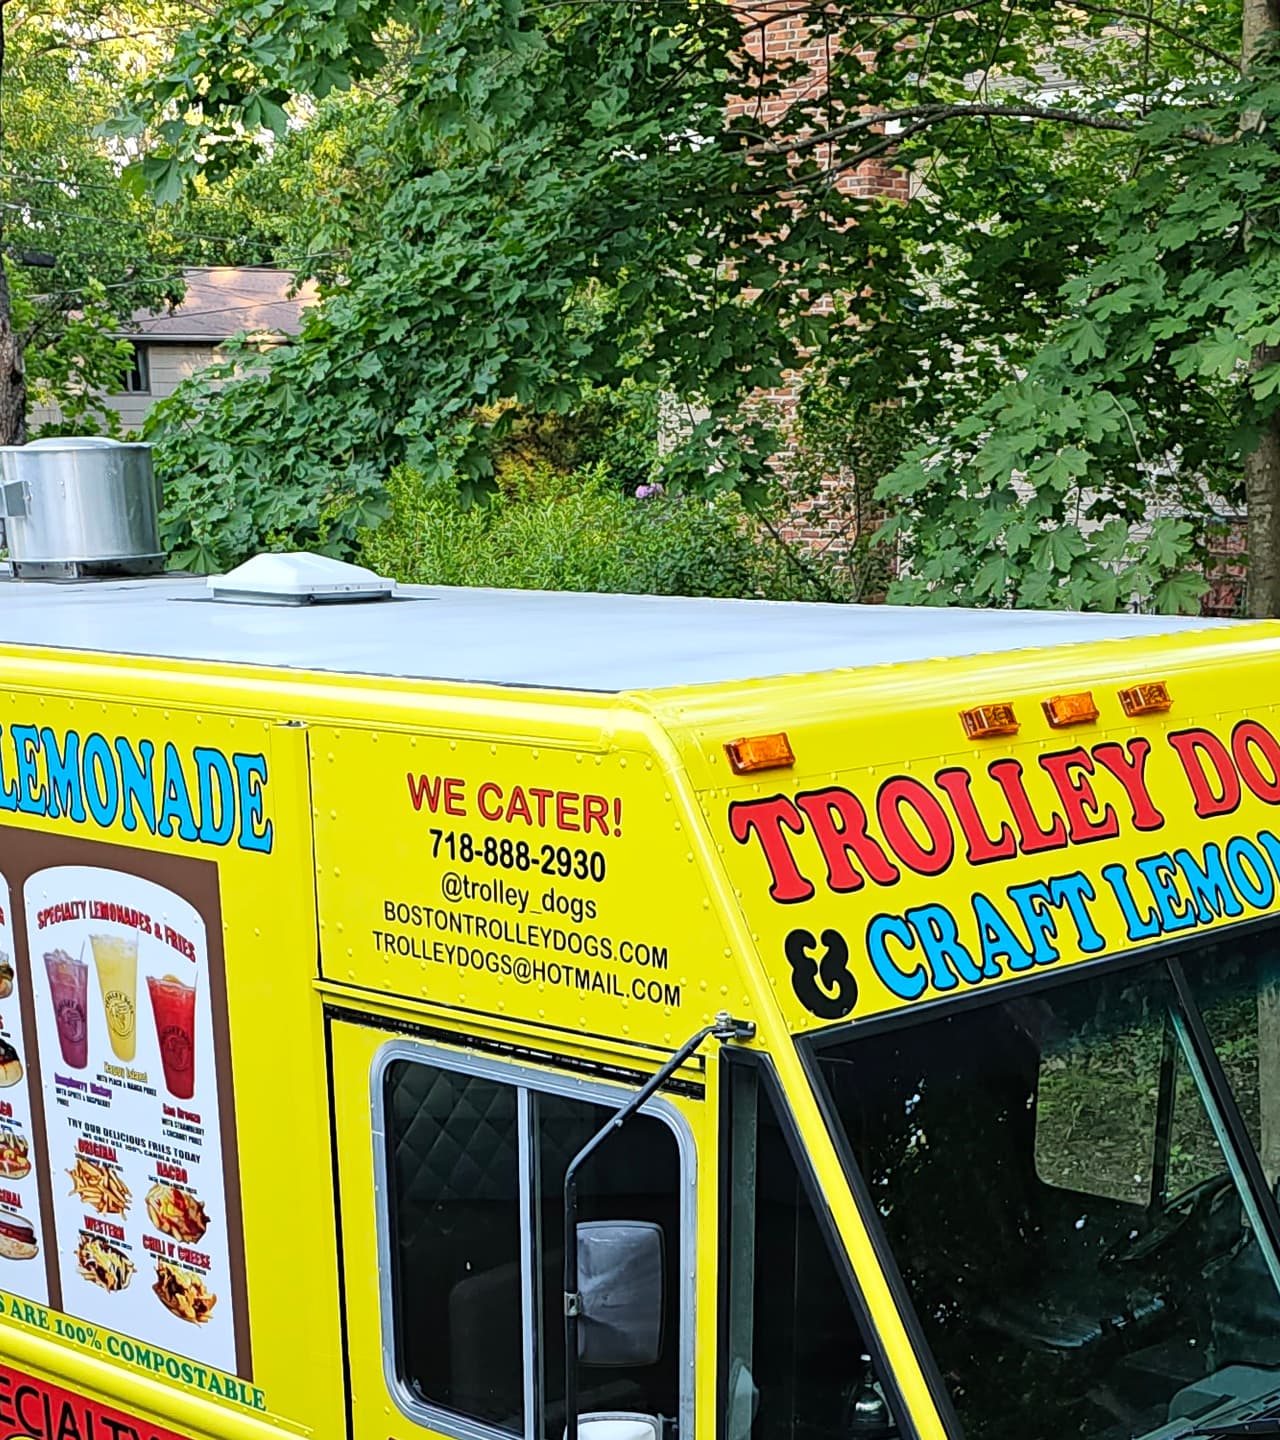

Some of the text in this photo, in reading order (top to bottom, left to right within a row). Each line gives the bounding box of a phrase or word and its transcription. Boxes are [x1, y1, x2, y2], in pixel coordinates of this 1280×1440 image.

[407, 772, 622, 837] WE CATER!
[728, 736, 1166, 904] TROLLEY
[429, 829, 606, 882] 718-888-2930
[441, 871, 597, 923] @trolley_dogs
[37, 900, 196, 963] SPECIALTY LEMONADES & FRIES
[384, 901, 669, 969] BOSTONTROLLEYDOGS.COM
[783, 928, 859, 1020] &
[866, 865, 1109, 1002] CRAFT
[372, 930, 681, 1007] TROLLEYDOGS@HOTMAIL.COM
[67, 1116, 82, 1129] TRY
[84, 1121, 101, 1135] OUR
[102, 1127, 146, 1148] DELICIOUS
[173, 1147, 200, 1164] TODAY
[10, 1299, 50, 1331] ARE
[55, 1318, 102, 1351] 100%
[107, 1335, 267, 1411] COMPOSTABLE
